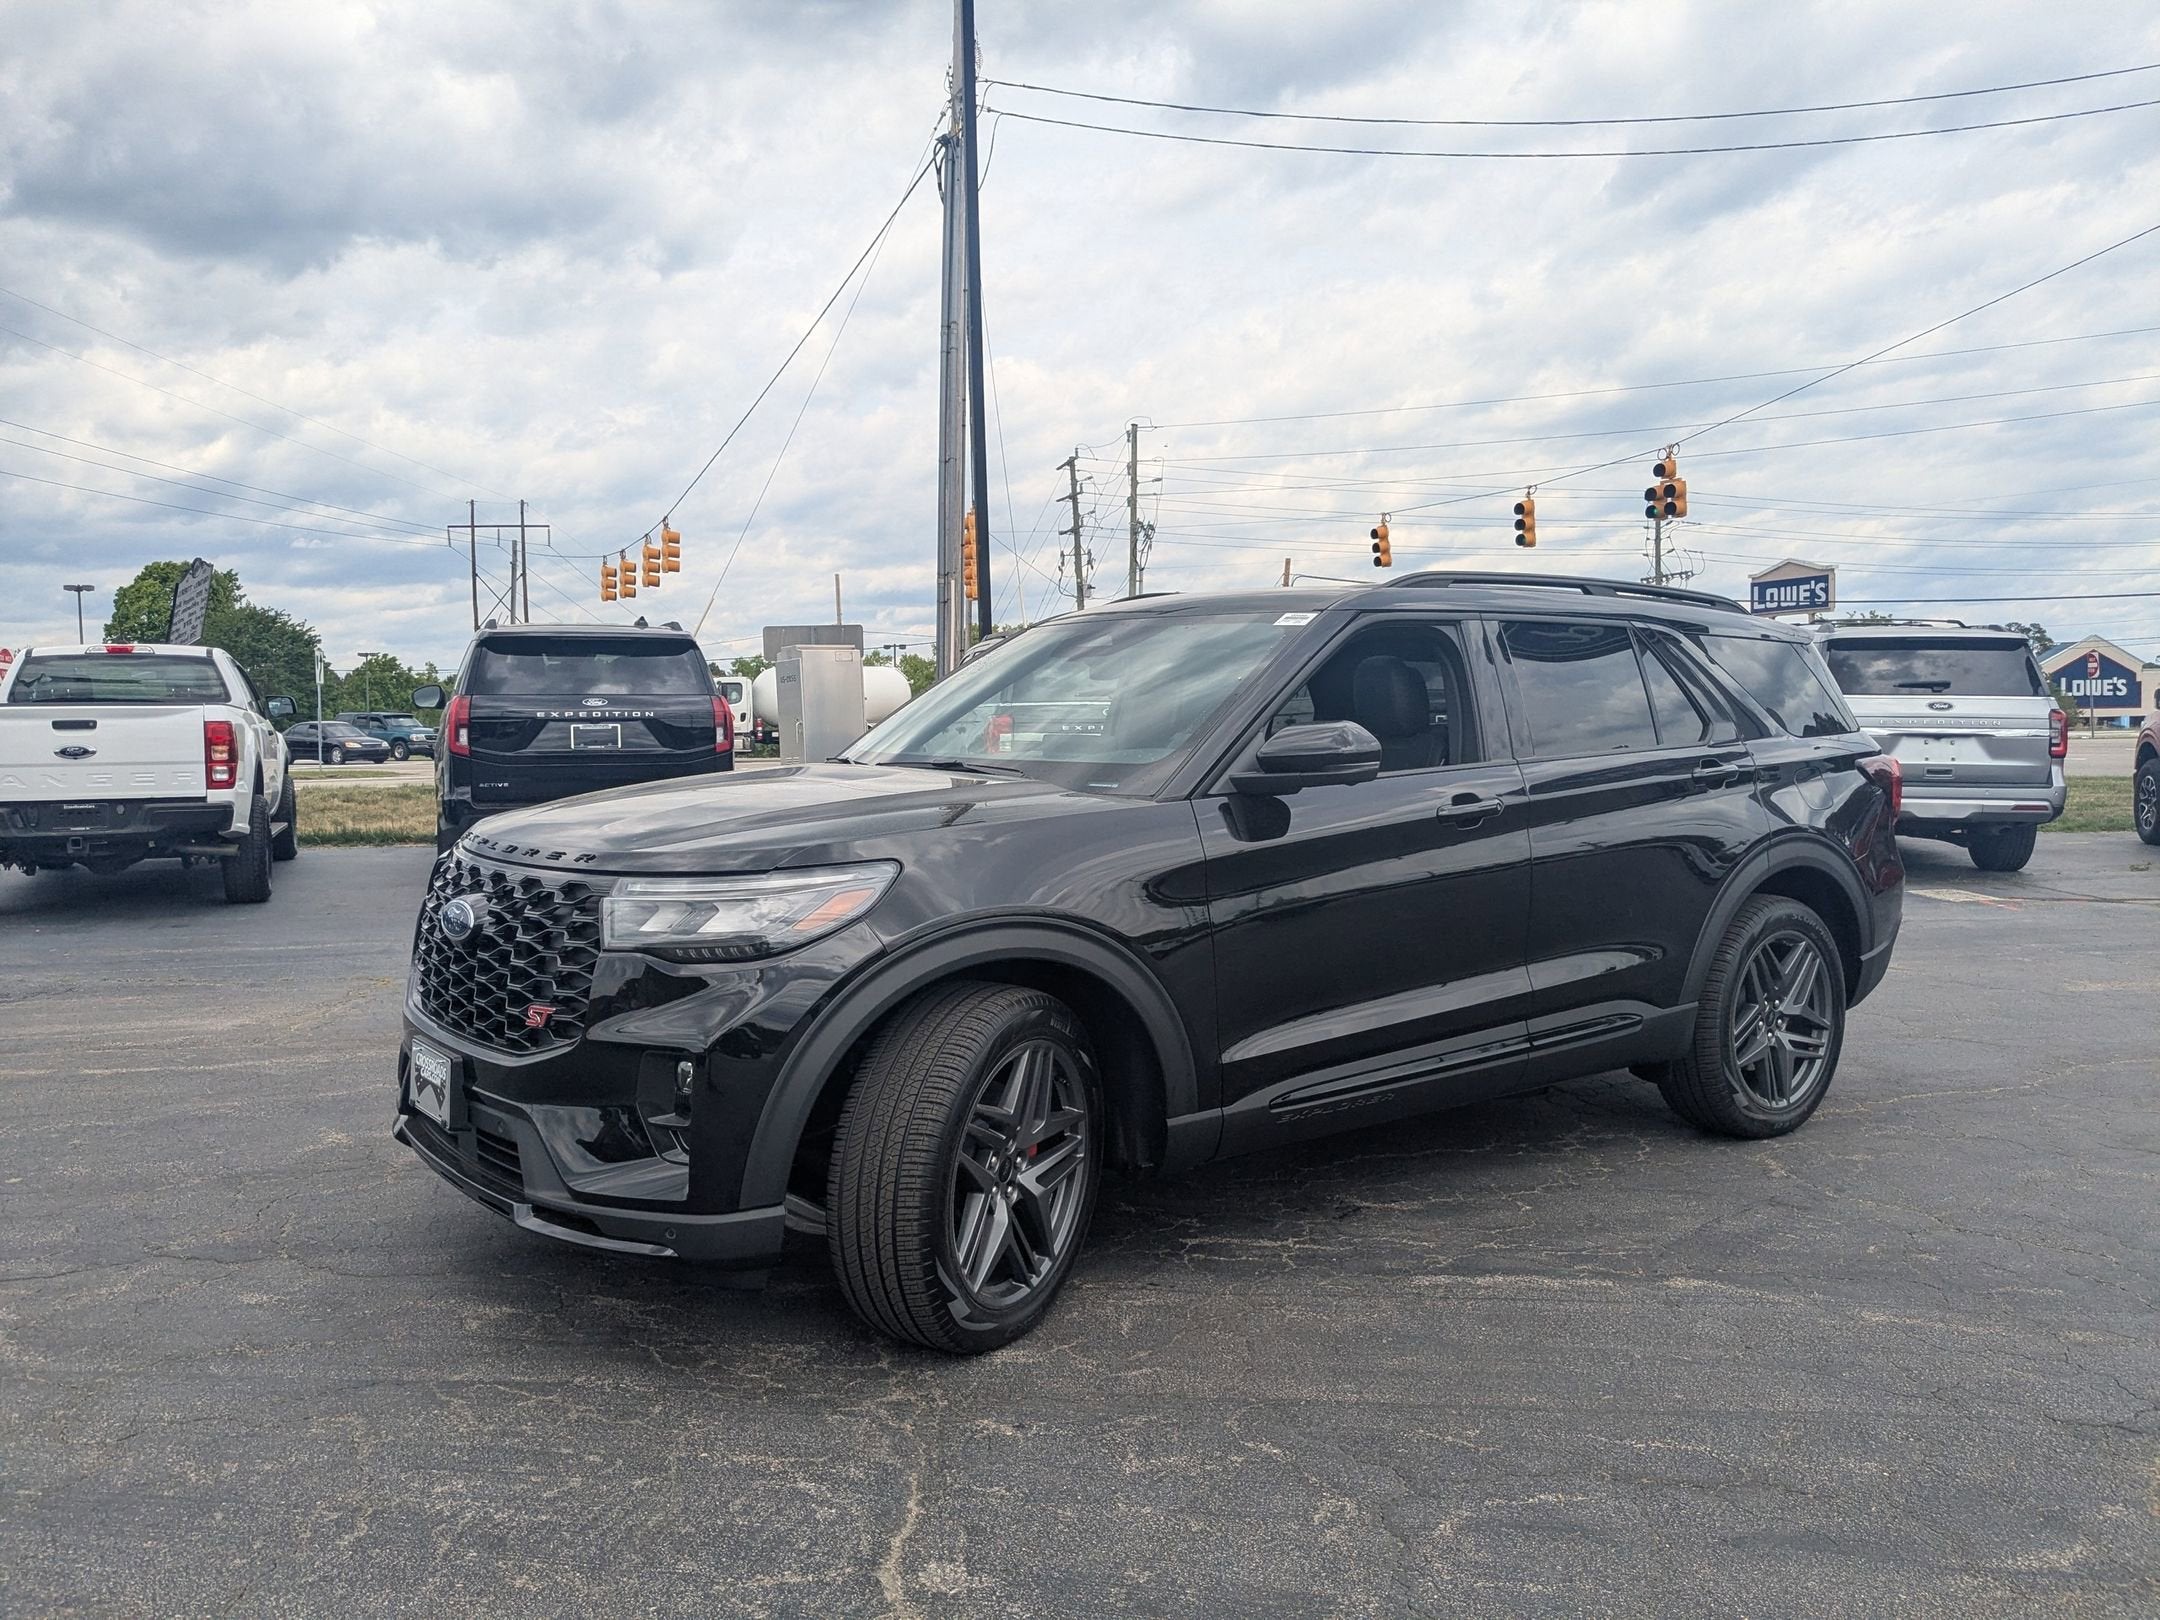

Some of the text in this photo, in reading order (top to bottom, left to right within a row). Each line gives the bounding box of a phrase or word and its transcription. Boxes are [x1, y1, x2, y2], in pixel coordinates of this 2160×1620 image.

[1753, 580, 1827, 610] LOWE'S
[2060, 676, 2128, 697] LOWE'S
[1879, 719, 2001, 727] EXPEDITION
[525, 1005, 556, 1028] ST
